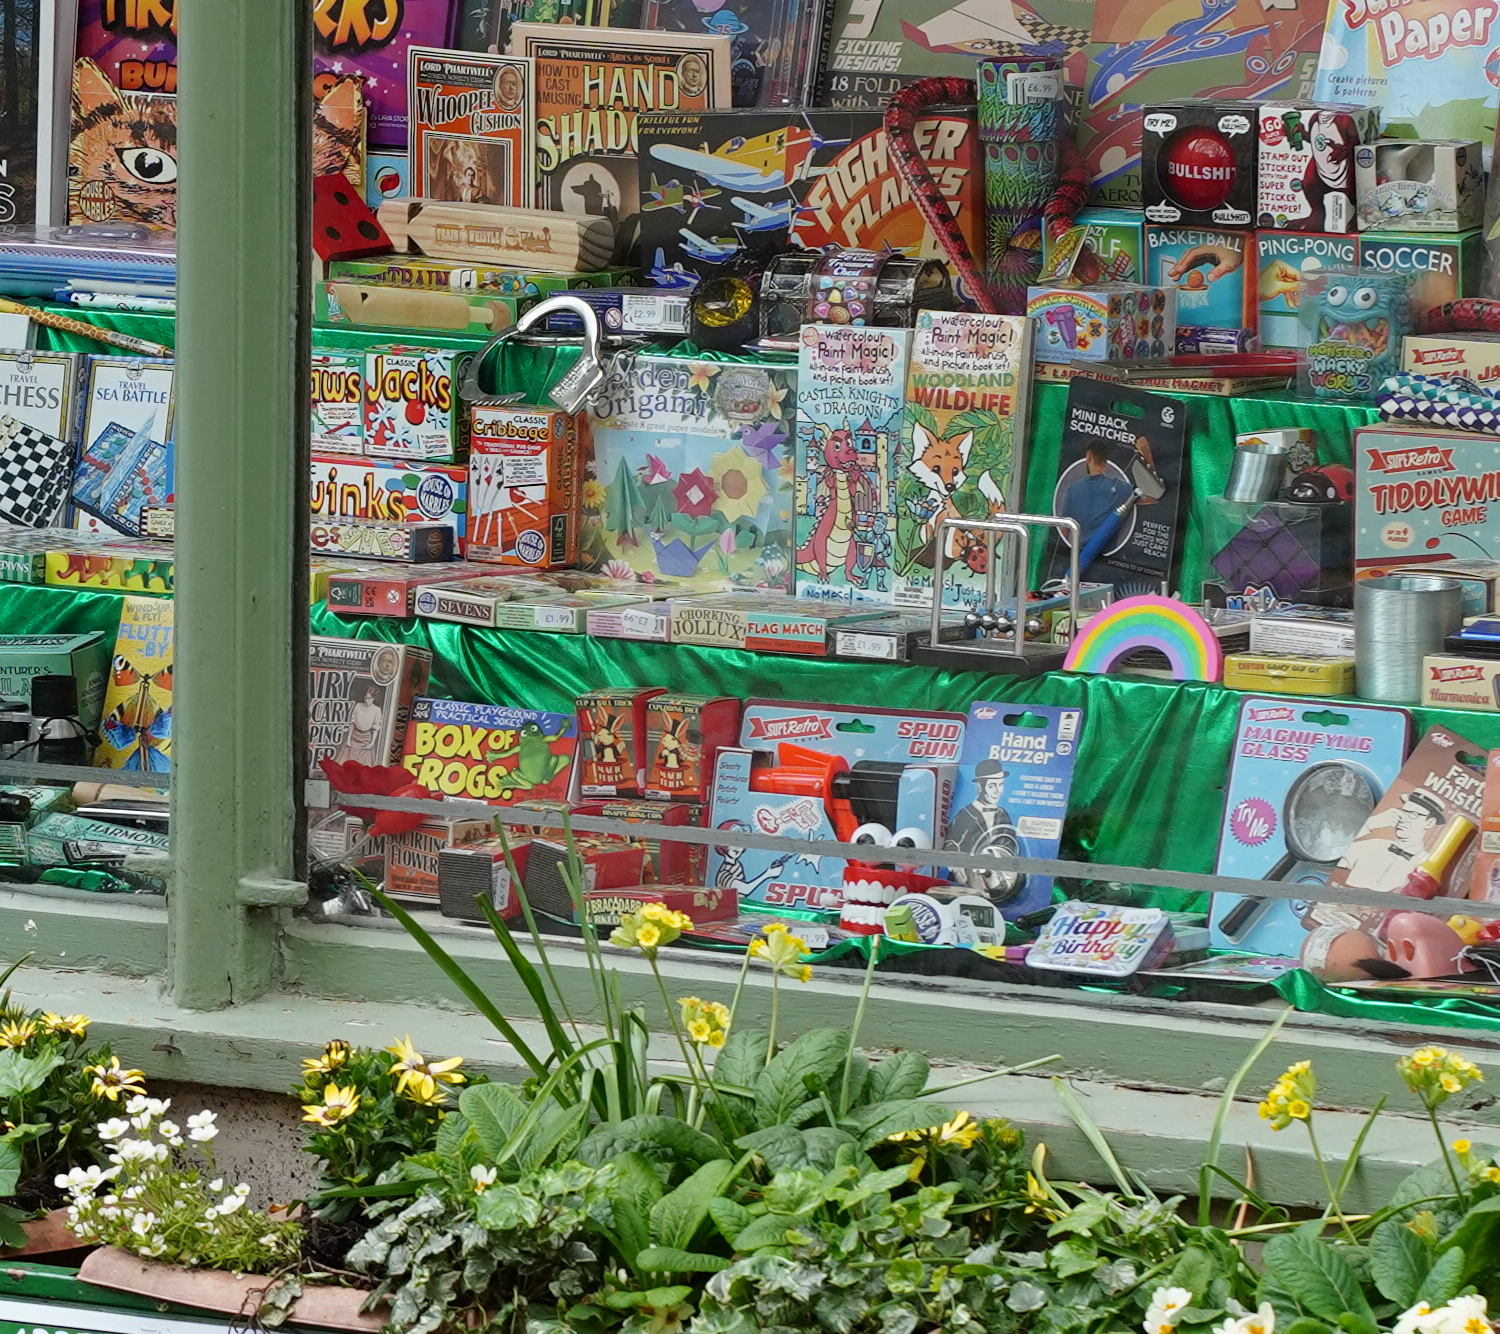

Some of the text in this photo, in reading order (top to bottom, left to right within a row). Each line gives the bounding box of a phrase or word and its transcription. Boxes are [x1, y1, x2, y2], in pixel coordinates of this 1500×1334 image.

[1381, 0, 1495, 61] Paper
[1148, 230, 1243, 254] BASKETBALL
[1365, 248, 1454, 275] SOCCER
[368, 361, 452, 404] Jacks
[439, 601, 492, 621] SEVENS
[748, 623, 823, 635] FLAG MATCH
[416, 722, 516, 760] BOX OF
[1241, 742, 1306, 763] GLASS
[1242, 728, 1373, 754] MAGNIFYING
[1051, 909, 1149, 939] Happy
[1051, 936, 1142, 958] Birthday
